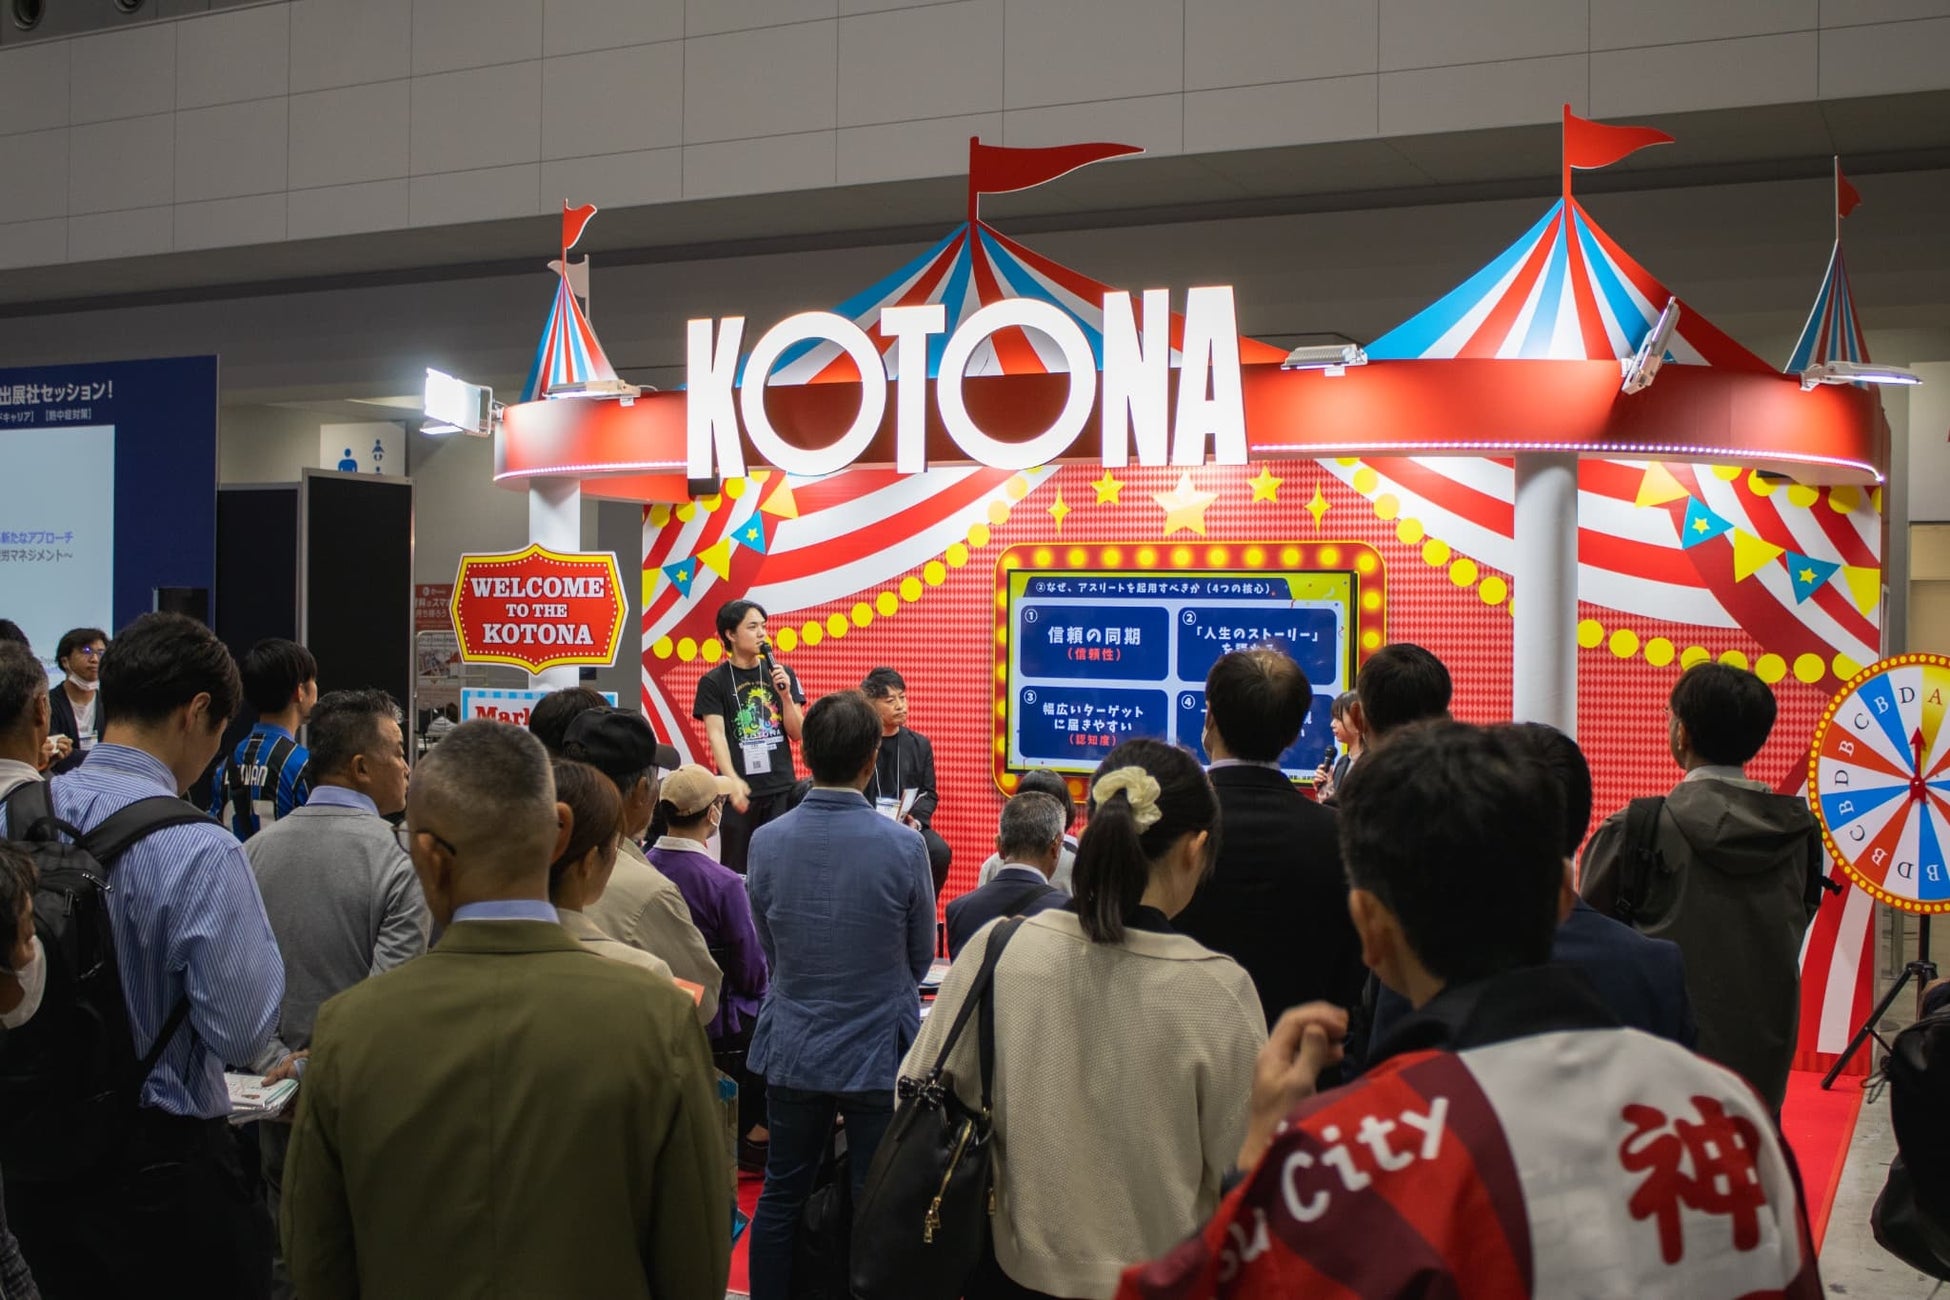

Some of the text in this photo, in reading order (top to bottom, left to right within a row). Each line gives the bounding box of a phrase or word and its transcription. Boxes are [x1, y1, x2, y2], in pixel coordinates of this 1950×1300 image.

[687, 285, 1248, 478] KOTONA
[470, 577, 605, 598] WELCOME
[506, 604, 568, 618] TO THE
[482, 623, 593, 645] KOTONA
[1048, 626, 1141, 646] 信頼の同期
[1196, 626, 1319, 642] 「人生のストーリー」
[1899, 686, 1916, 704] D
[1928, 688, 1943, 706] A
[1042, 702, 1144, 718] 幅広いターゲット
[1873, 696, 1889, 714] B
[1054, 719, 1132, 733] に届きやすい
[1854, 713, 1869, 731] C
[1839, 740, 1854, 756] B
[1834, 769, 1849, 786] D
[1838, 800, 1854, 815] B
[1850, 825, 1865, 842] C
[1871, 847, 1888, 866] B
[1897, 861, 1914, 879] D
[1926, 864, 1941, 881] B
[1282, 1097, 1449, 1222] City
[1620, 1096, 1766, 1265] 神
